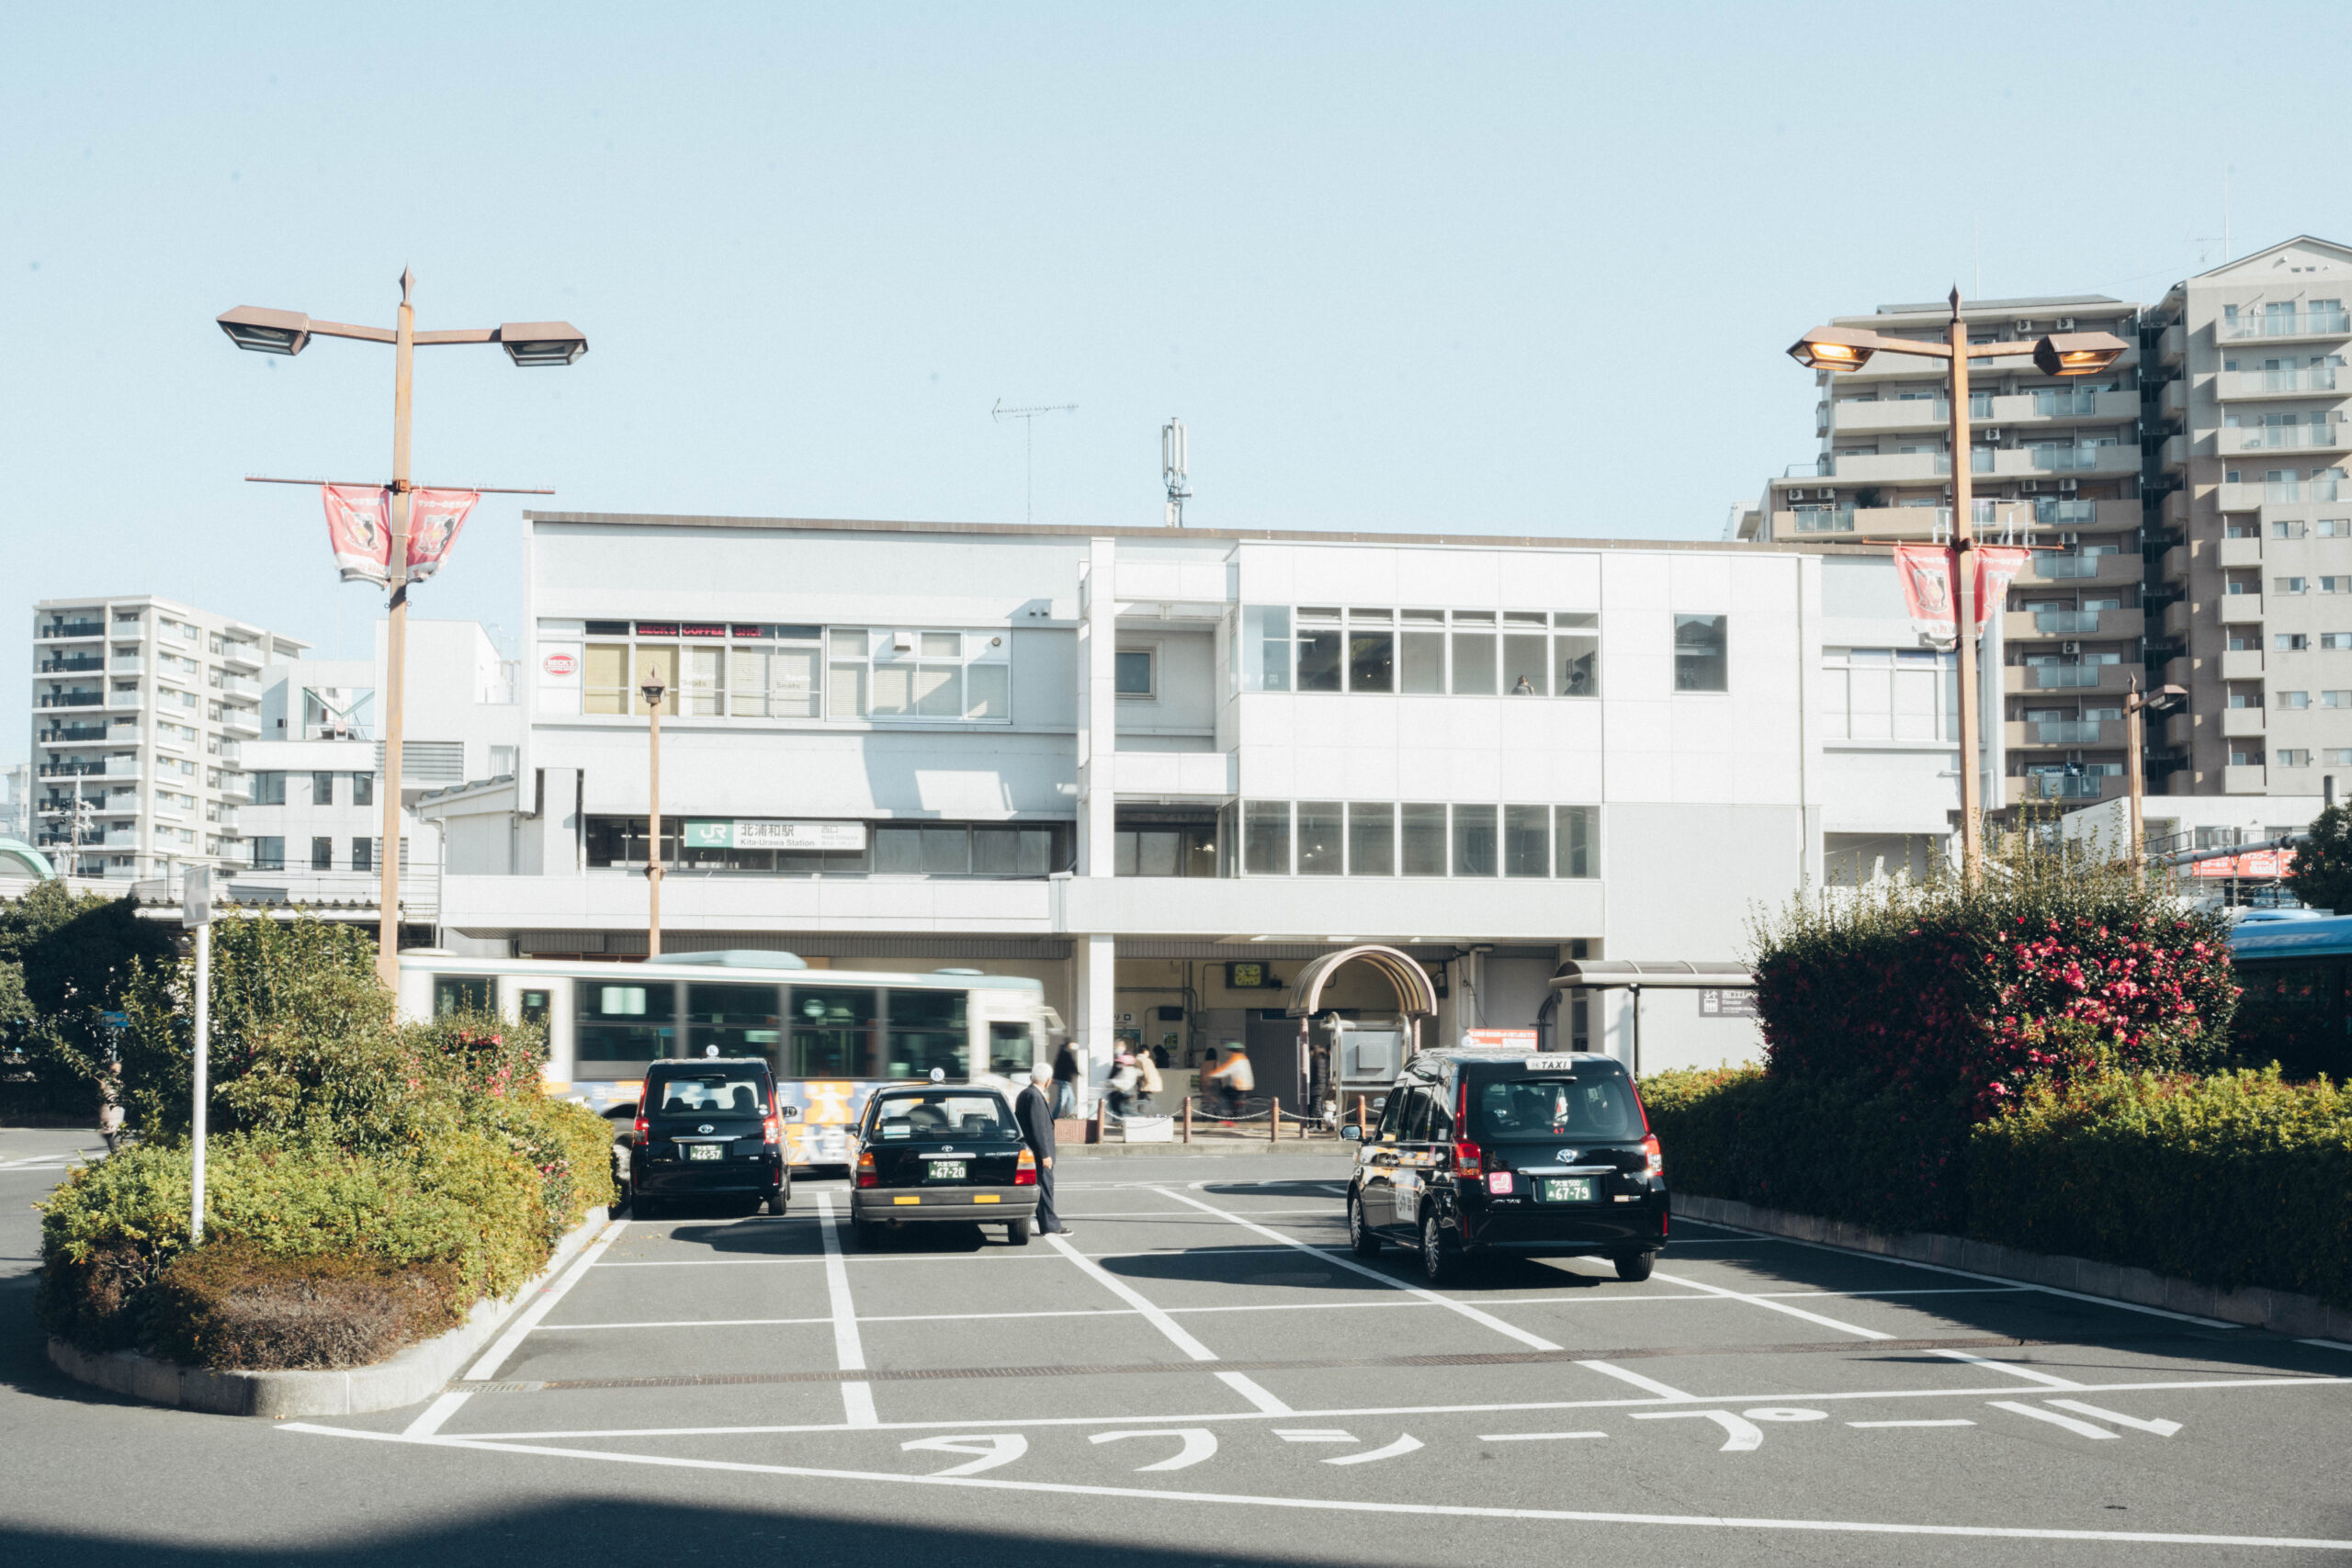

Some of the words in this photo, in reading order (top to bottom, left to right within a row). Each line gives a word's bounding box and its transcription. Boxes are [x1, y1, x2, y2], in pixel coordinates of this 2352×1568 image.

[683, 626, 726, 636] COFFEE
[735, 627, 765, 637] SHOP
[700, 824, 726, 839] JR
[741, 823, 795, 837] 北浦和駅
[741, 839, 785, 847] Kita-Urawa
[786, 839, 815, 847] Station
[1542, 1061, 1567, 1069] TAXI
[697, 1150, 721, 1159] 66-57
[937, 1167, 965, 1178] 67-20
[1555, 1187, 1589, 1200] 67-79
[900, 1398, 2184, 1477] タクシープール
